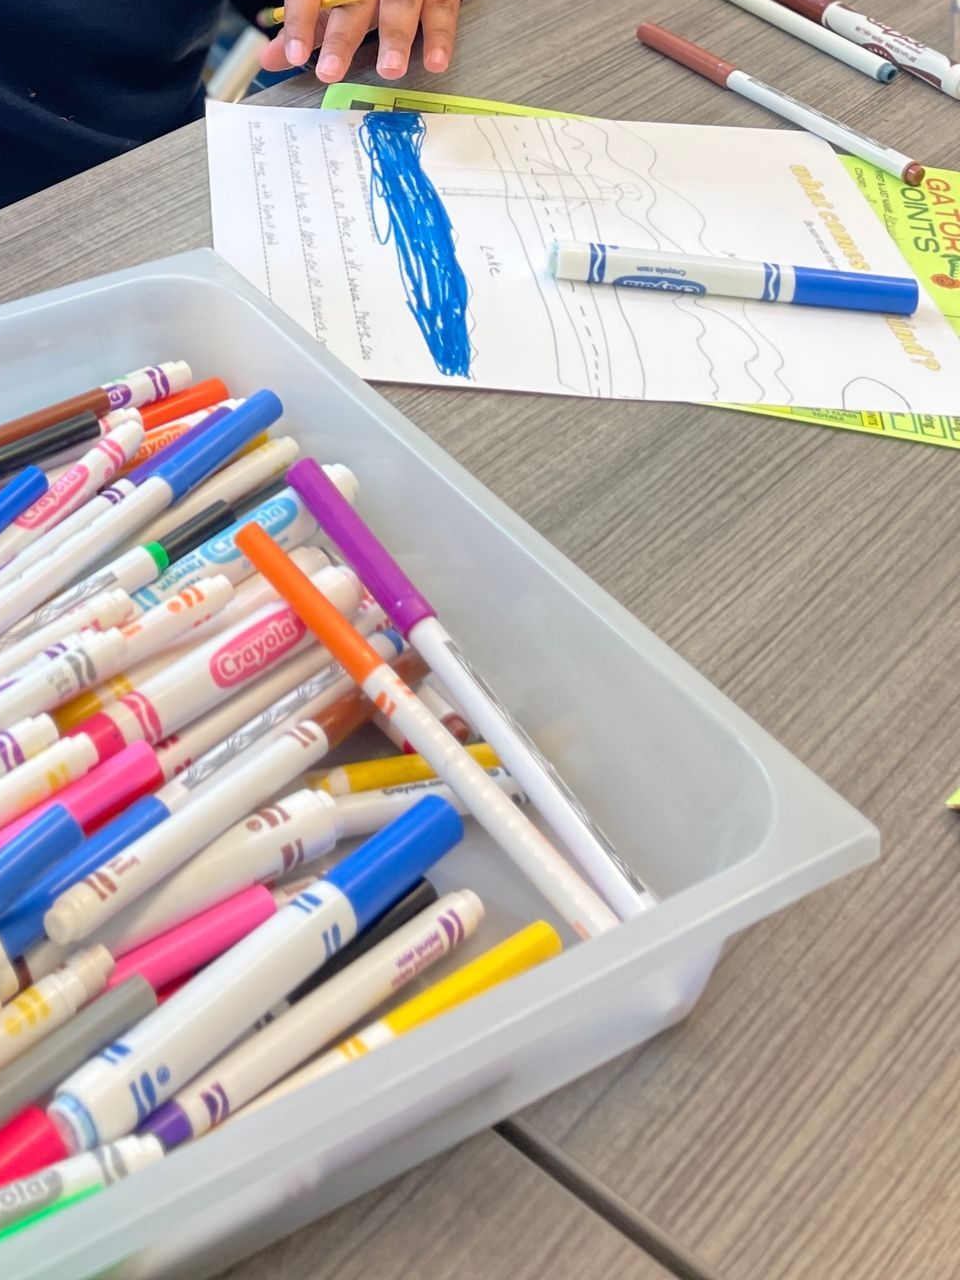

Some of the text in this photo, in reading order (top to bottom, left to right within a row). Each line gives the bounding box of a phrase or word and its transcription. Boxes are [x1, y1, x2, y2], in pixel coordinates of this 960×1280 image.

[790, 164, 871, 271] what comes
[901, 187, 940, 253] OINTS
[926, 178, 960, 252] GATOR
[479, 245, 500, 276] Lake
[21, 468, 82, 523] Crayola
[206, 502, 284, 561] Crla
[216, 615, 299, 679] Crayola
